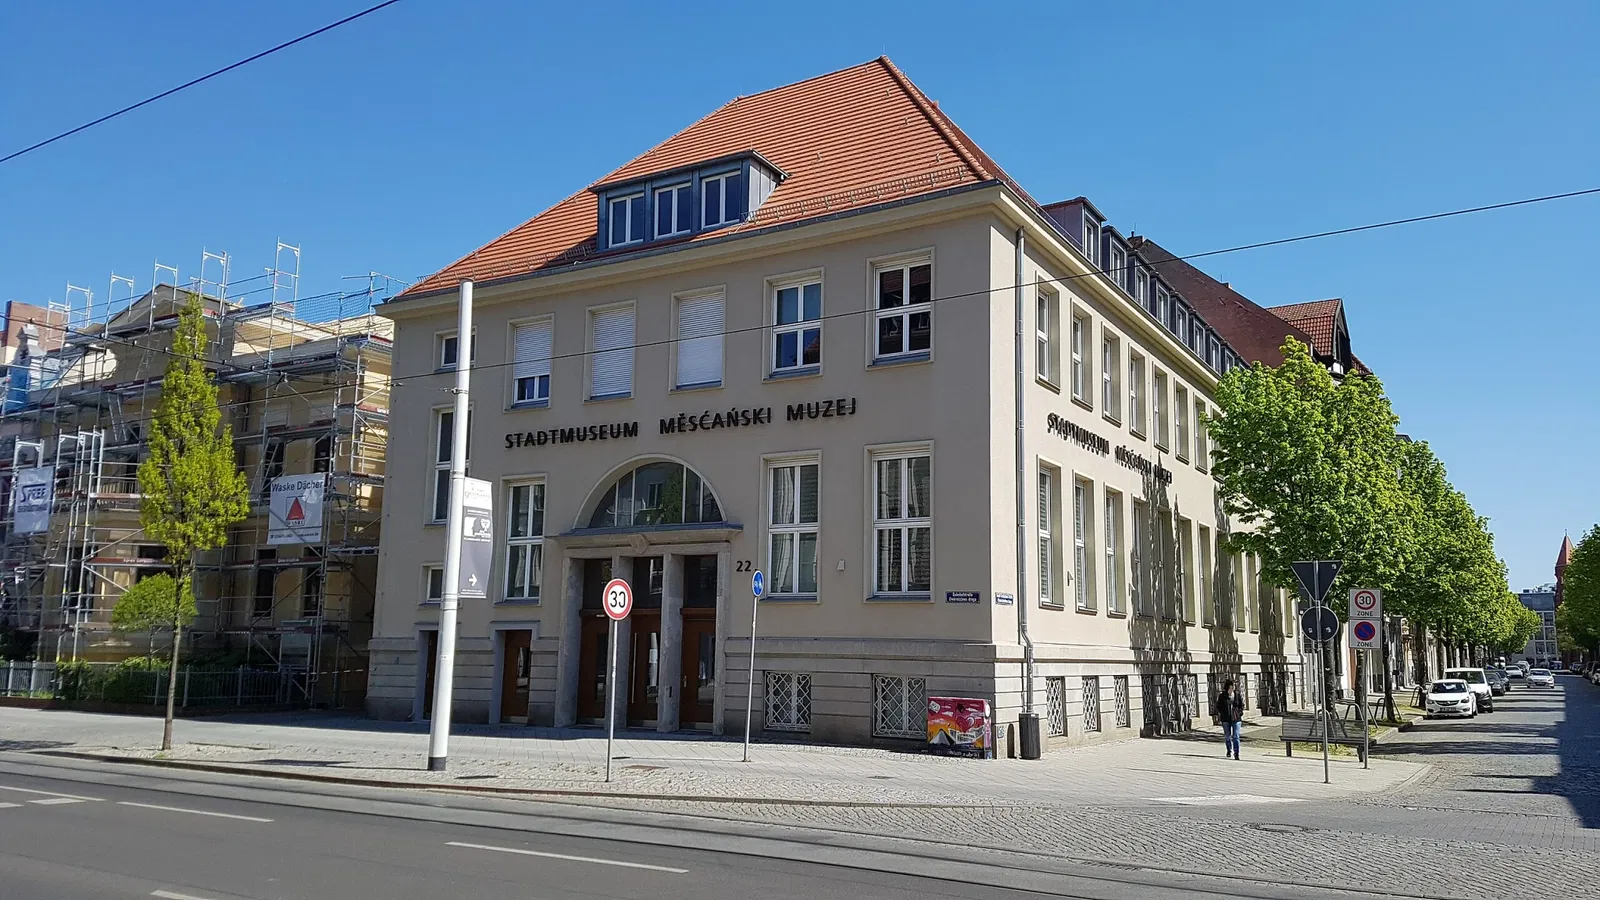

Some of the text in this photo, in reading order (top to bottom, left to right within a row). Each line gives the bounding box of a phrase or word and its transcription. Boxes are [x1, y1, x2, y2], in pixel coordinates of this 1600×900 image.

[505, 397, 857, 449] STADTMUSEUM MĚSĆAŃSKI MUZEJ
[1047, 412, 1110, 456] STADTMUSEUM
[272, 480, 323, 492] Waske Dächer
[736, 560, 752, 572] 22
[1359, 596, 1371, 605] 30
